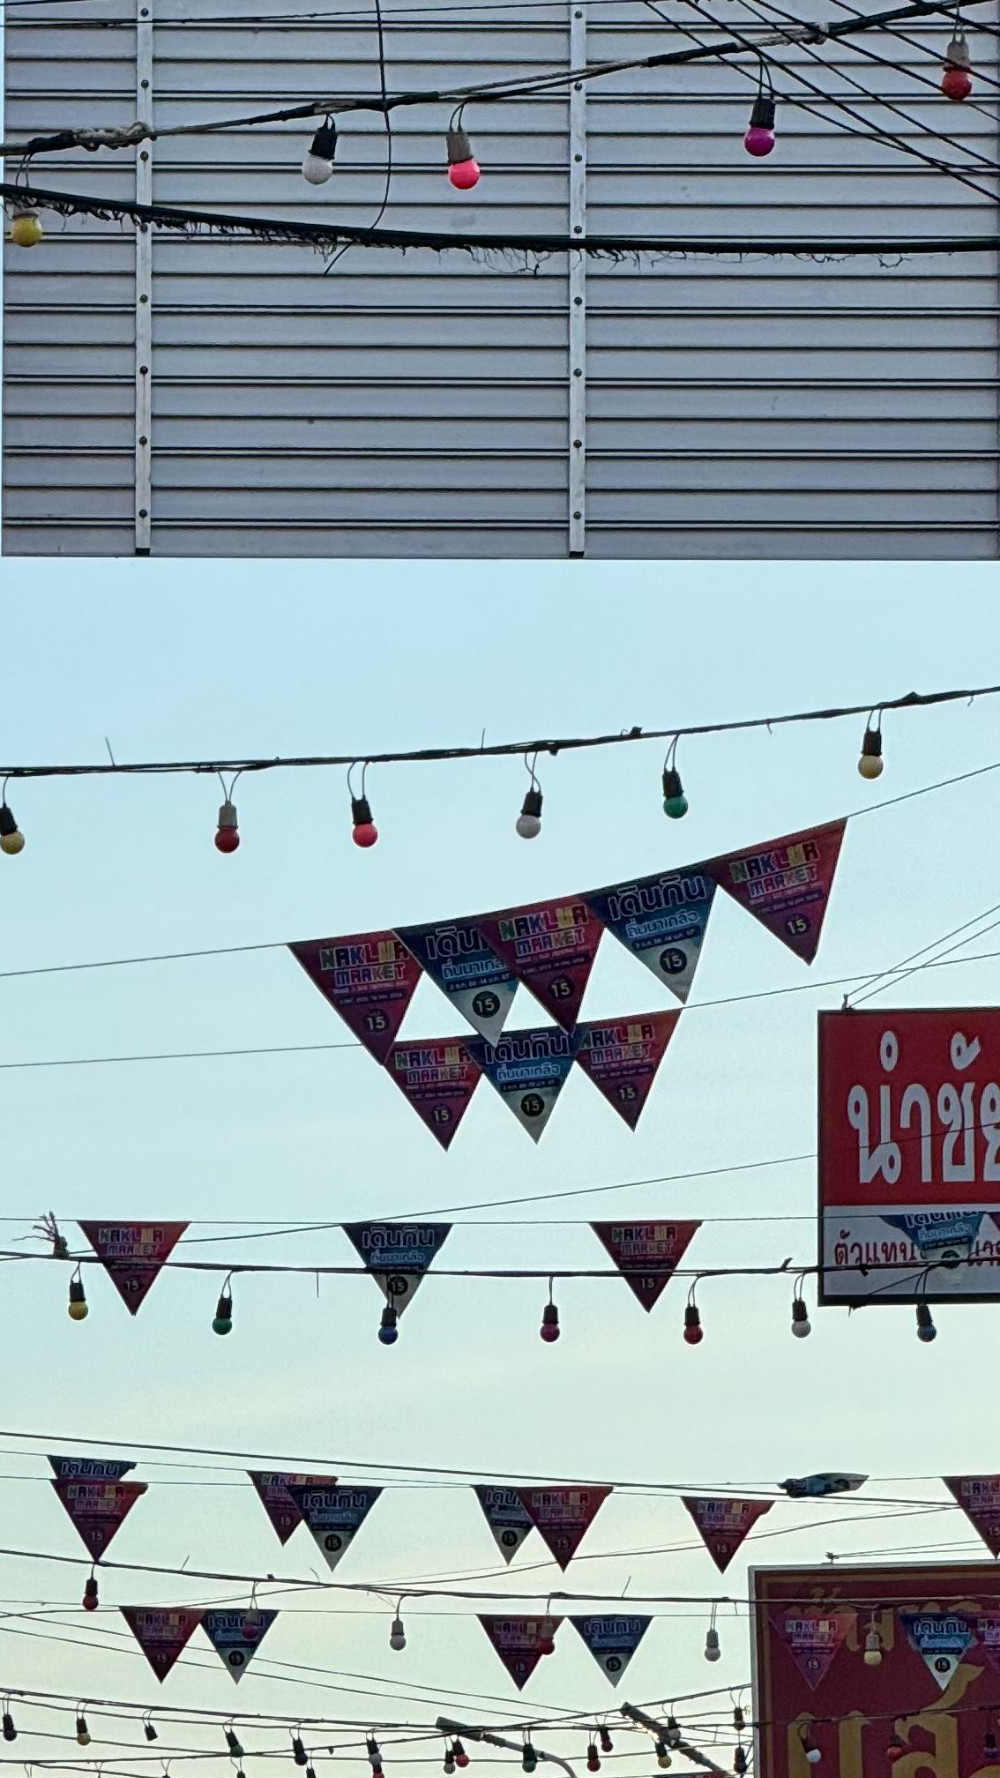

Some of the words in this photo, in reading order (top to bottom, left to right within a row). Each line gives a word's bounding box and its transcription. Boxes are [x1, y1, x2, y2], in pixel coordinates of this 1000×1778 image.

[729, 839, 820, 884] NAKLUA
[747, 863, 818, 899] MARKET
[607, 873, 708, 922] เดินกิน
[498, 903, 589, 942] NAKLUA
[788, 918, 807, 934] 15
[515, 926, 586, 957] MARKET
[664, 954, 682, 969] 15
[334, 962, 406, 987] MARKET
[551, 985, 570, 998] 15
[476, 999, 495, 1013] 15
[367, 1017, 385, 1030] 15
[590, 1043, 652, 1065] MARKET
[407, 1065, 468, 1084] MARKET
[619, 1088, 635, 1099] 15
[523, 1099, 541, 1112] 15
[434, 1108, 449, 1121] 15
[99, 1227, 165, 1243] NAKLUA
[362, 1225, 435, 1249] เดินกิน
[611, 1226, 678, 1243] NAKLUA
[126, 1280, 140, 1291] 15
[640, 1278, 654, 1288] 15
[302, 1489, 366, 1509] เดินกิน
